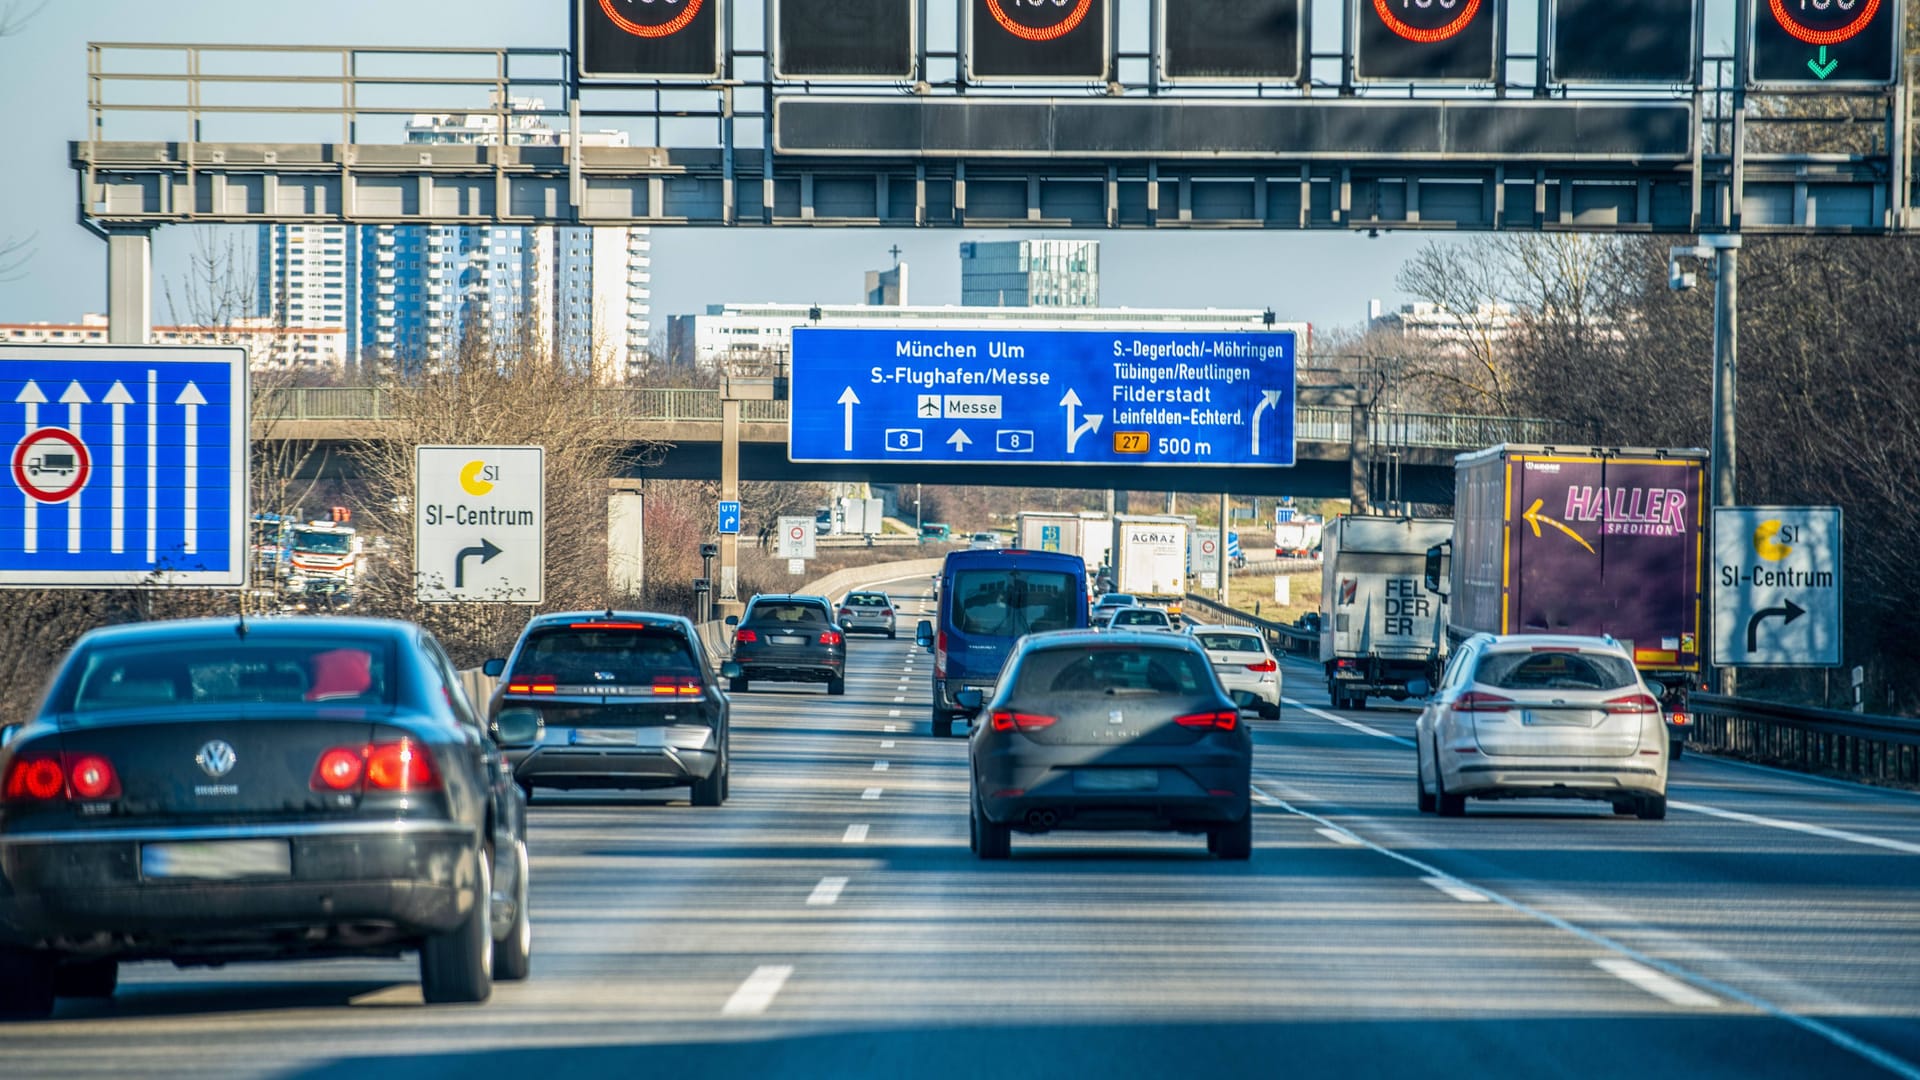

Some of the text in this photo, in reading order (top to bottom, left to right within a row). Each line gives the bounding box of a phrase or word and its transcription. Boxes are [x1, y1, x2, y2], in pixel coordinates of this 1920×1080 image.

[896, 340, 1025, 358] München Ulm
[1113, 340, 1283, 361] S.-Degerloch/-Möhringen
[870, 366, 1050, 388] S.-Flughafen/Messe
[1113, 362, 1250, 384] Tübingen/Reutlingen
[1113, 386, 1211, 403] Filderstadt
[949, 399, 997, 415] Messe
[1113, 408, 1244, 426] Leinfelden-Echterd.
[898, 433, 909, 449] 8
[1010, 434, 1020, 449] 8
[1122, 435, 1140, 450] 27
[1158, 437, 1212, 455] 500 m
[482, 465, 500, 481] SI
[425, 504, 534, 527] SI-Centrum
[721, 504, 737, 513] U 17
[1563, 485, 1687, 533] HALLER
[1607, 522, 1673, 536] SPEDITION
[1780, 525, 1801, 544] SI
[1720, 564, 1834, 589] SI-Centrum
[1385, 578, 1426, 598] FEL
[1385, 598, 1430, 617] DER
[1385, 616, 1414, 636] ER
